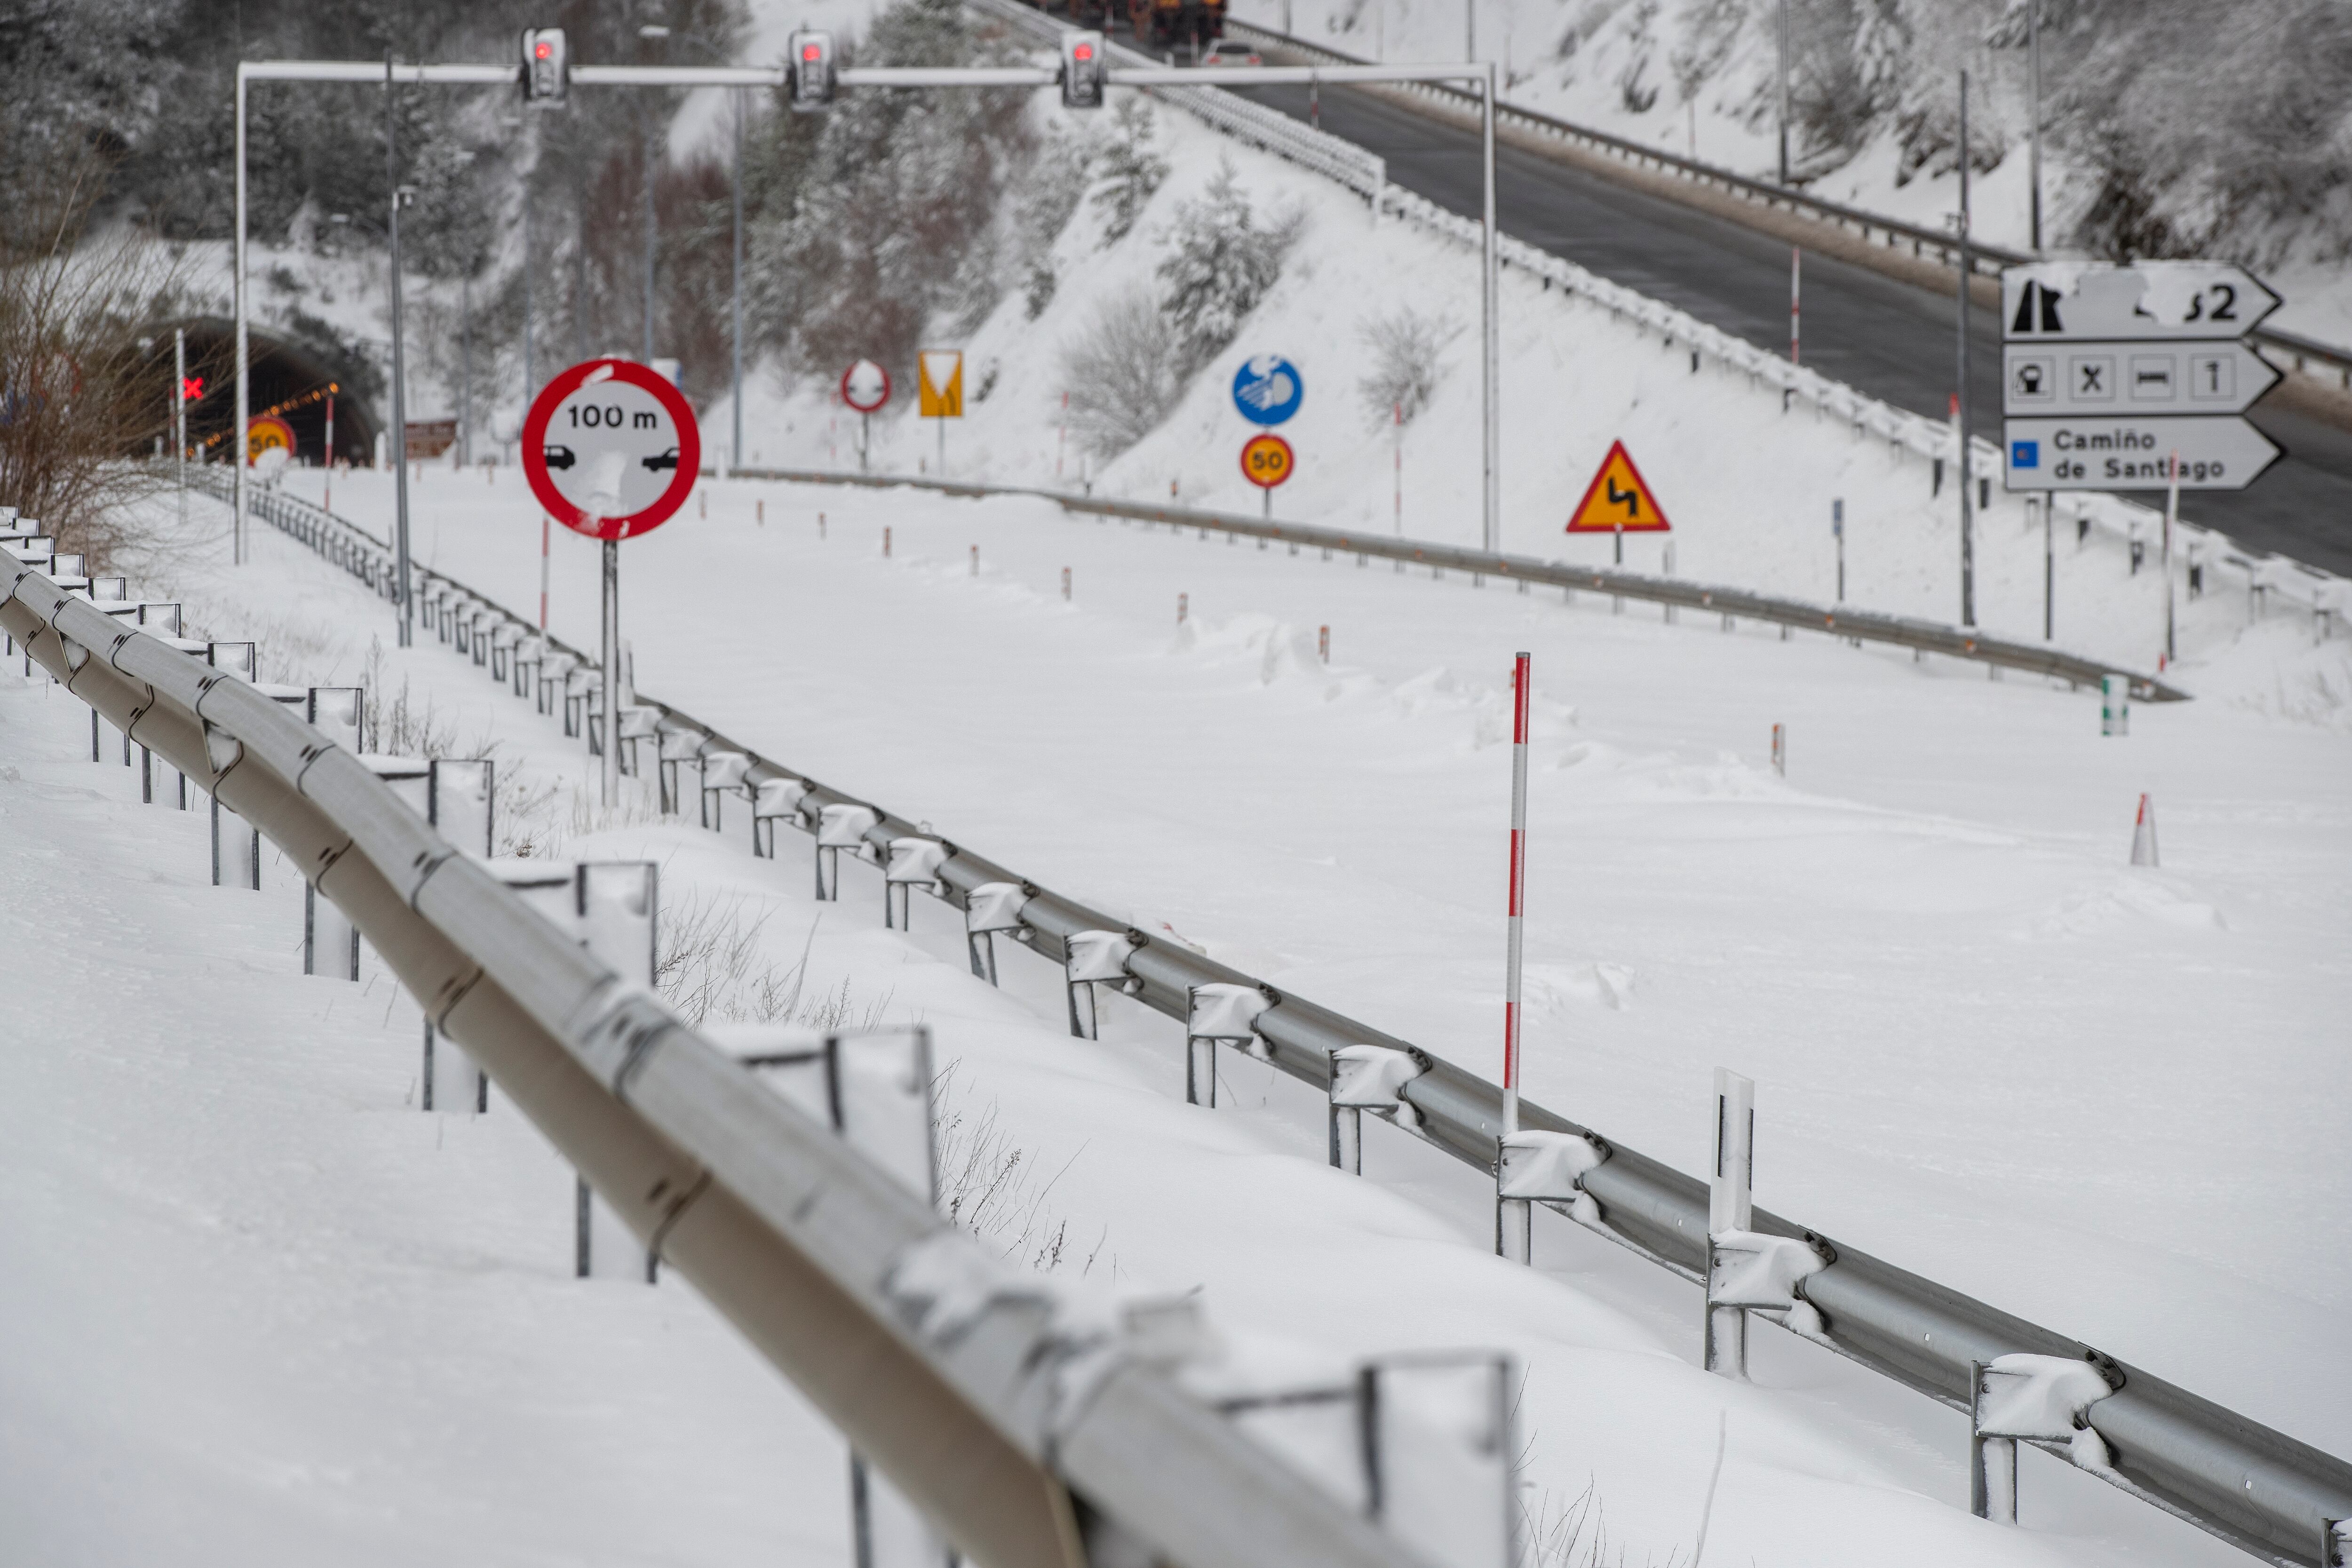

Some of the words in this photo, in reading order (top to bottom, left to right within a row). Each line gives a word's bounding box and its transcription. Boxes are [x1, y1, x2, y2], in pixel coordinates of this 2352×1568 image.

[568, 405, 623, 429] 100
[633, 411, 657, 429] m
[2053, 428, 2156, 451] Camiño
[1253, 450, 1284, 470] 50
[2054, 457, 2086, 479] de
